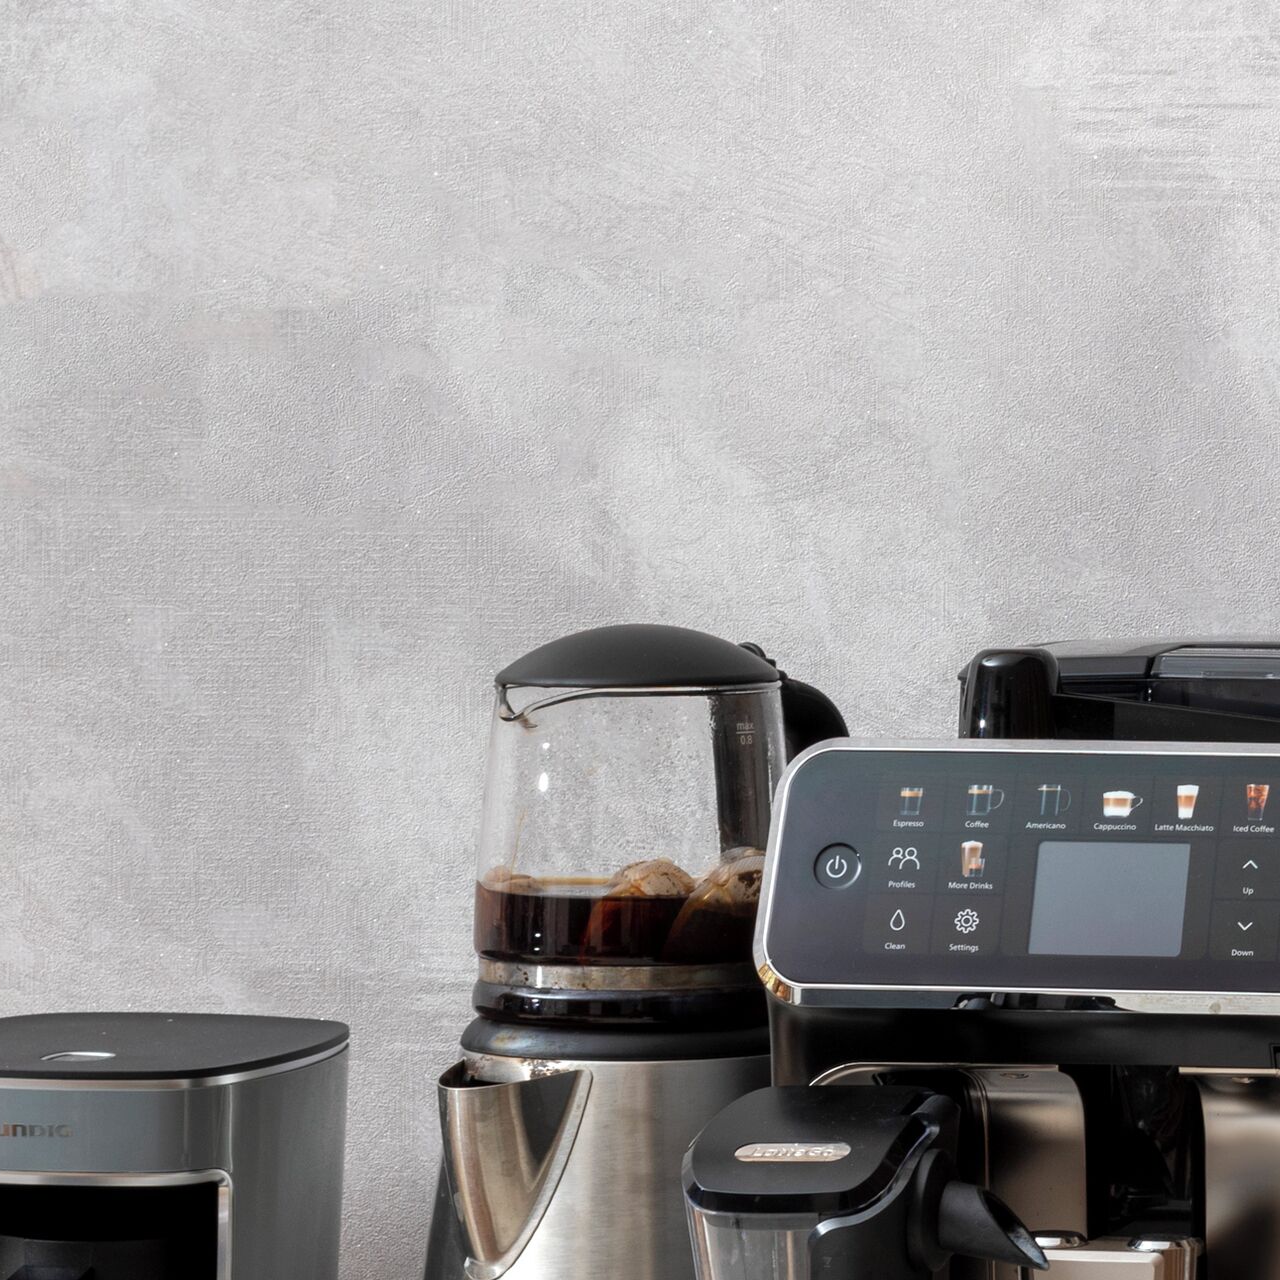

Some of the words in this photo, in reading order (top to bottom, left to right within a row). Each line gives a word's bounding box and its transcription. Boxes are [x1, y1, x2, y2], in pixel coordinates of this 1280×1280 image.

[893, 819, 924, 829] Espresso
[964, 820, 989, 829] Coffee
[1025, 821, 1066, 830] Americano
[1093, 822, 1136, 832] Cappuccino
[1154, 823, 1174, 831] Latte
[1175, 823, 1214, 832] Macchiato
[1232, 824, 1248, 833] Iced
[1249, 824, 1275, 834] Coffee
[888, 880, 916, 889] Profiles
[948, 881, 968, 890] More
[969, 881, 993, 890] Drinks
[1242, 886, 1254, 896] Up
[884, 942, 906, 950] Clean
[949, 943, 979, 953] Settings
[1231, 948, 1254, 957] Down
